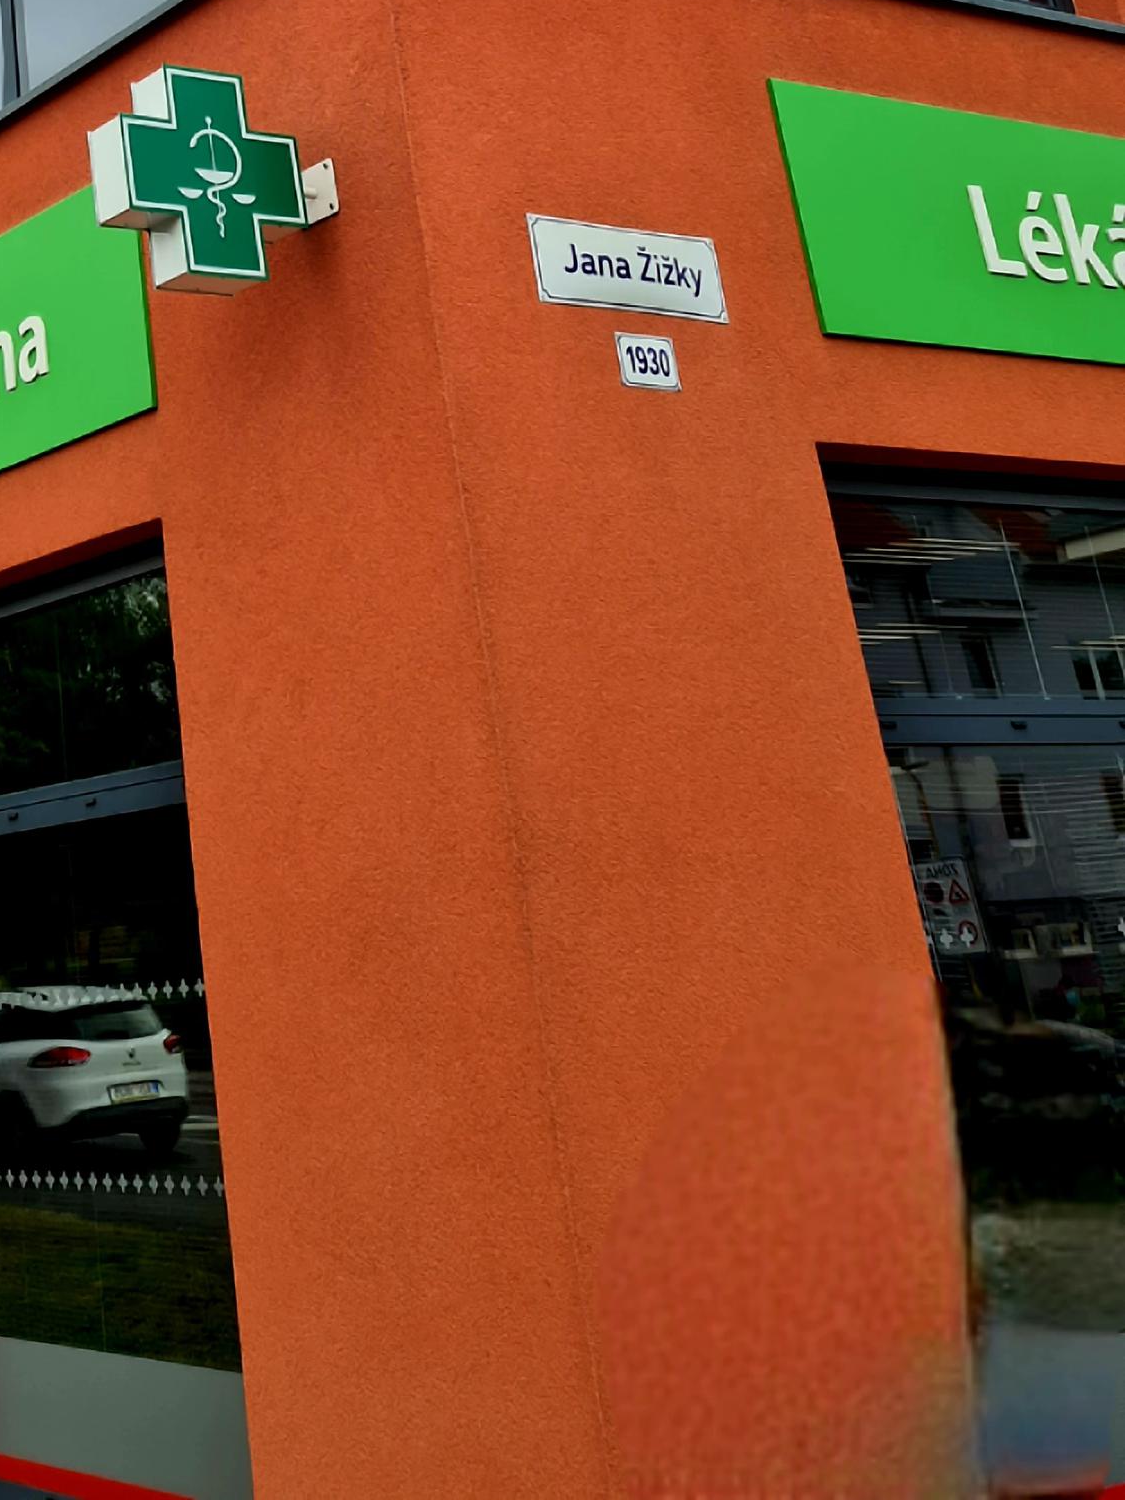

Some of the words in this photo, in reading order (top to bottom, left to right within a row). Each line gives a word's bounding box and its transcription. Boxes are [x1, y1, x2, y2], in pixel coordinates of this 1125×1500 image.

[564, 243, 632, 279] Jana
[637, 246, 702, 298] Žižky
[626, 346, 670, 377] 1930
